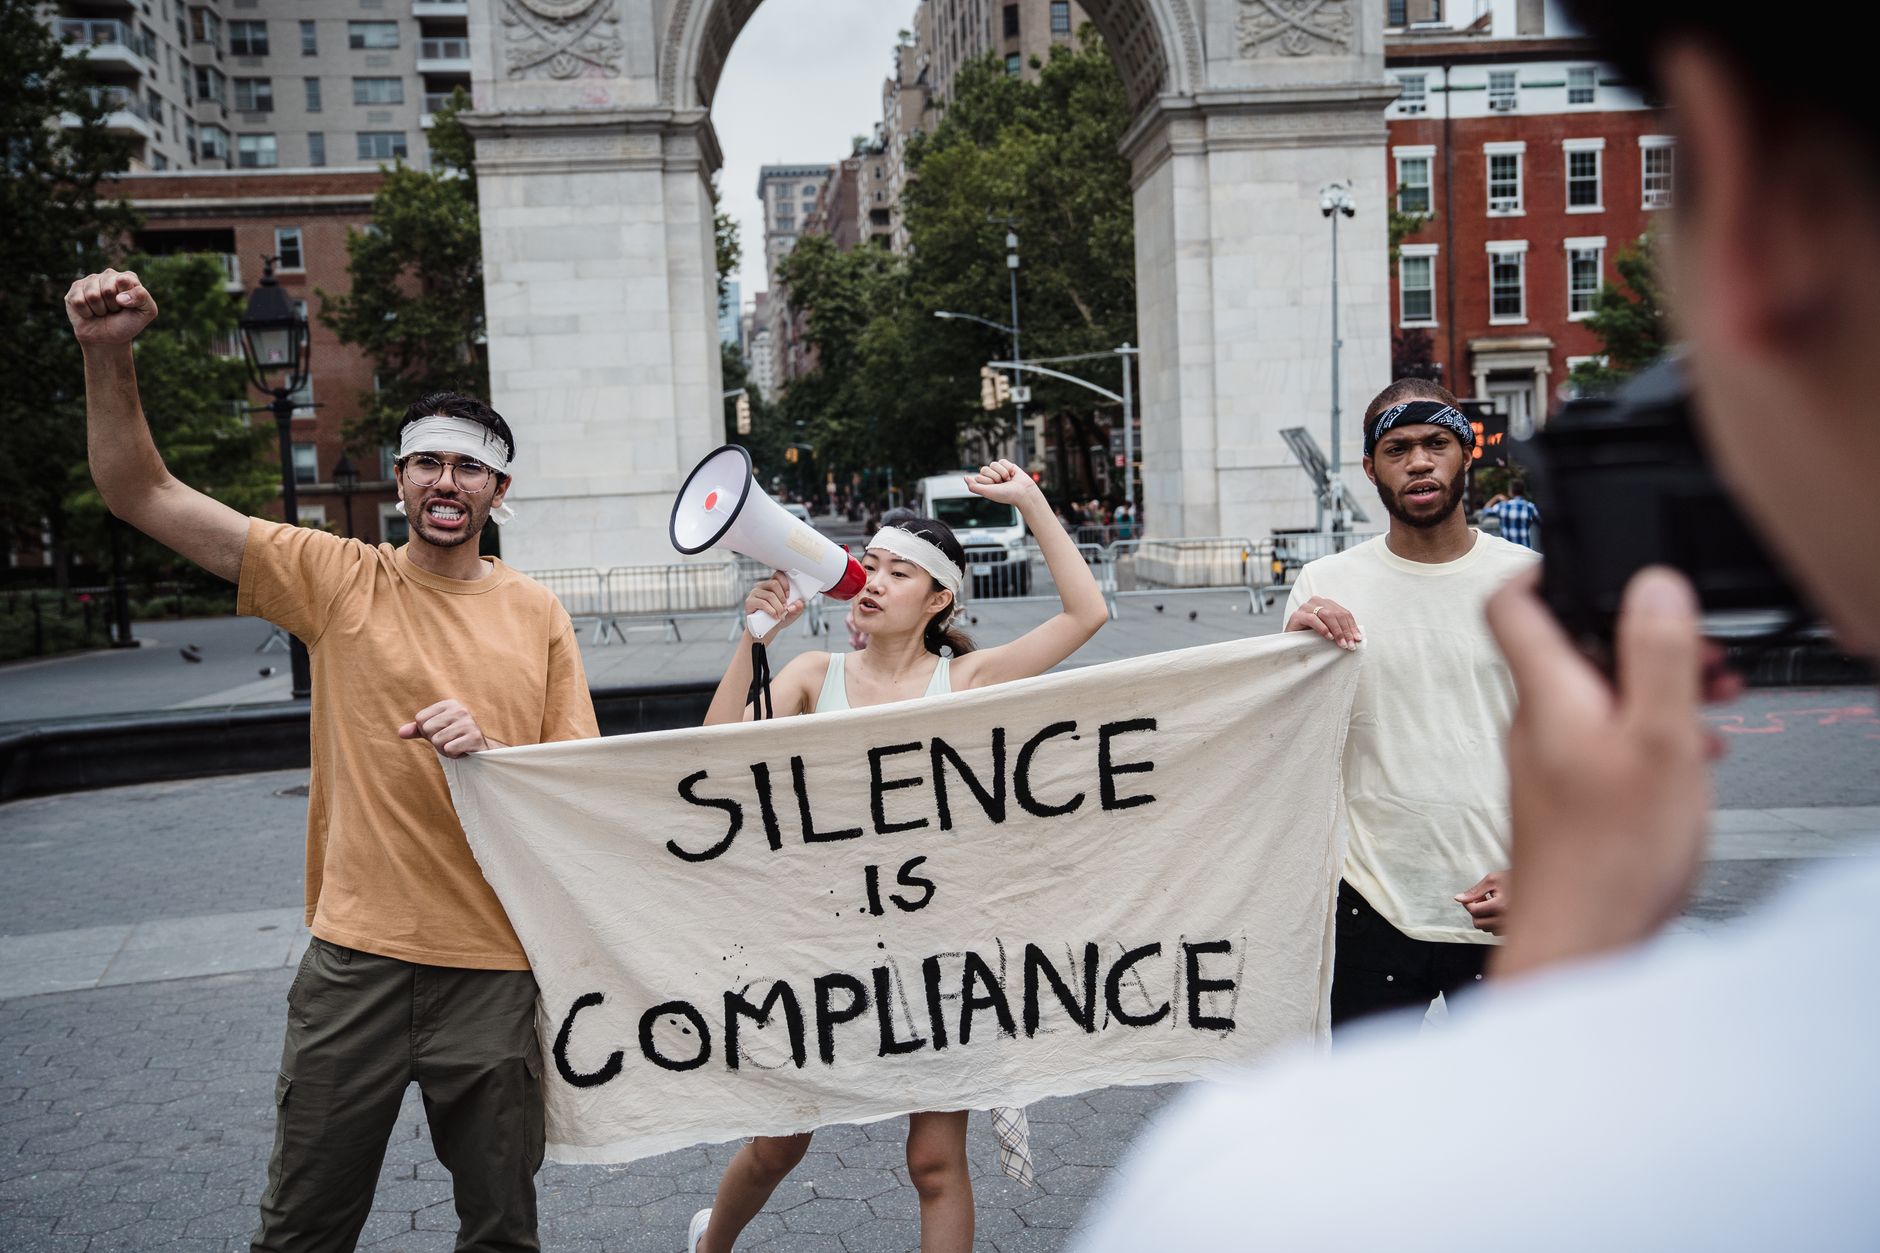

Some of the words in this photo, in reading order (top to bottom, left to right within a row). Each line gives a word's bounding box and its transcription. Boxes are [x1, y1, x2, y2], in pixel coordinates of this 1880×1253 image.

[666, 717, 1157, 863] SILENCE
[865, 855, 937, 917] IS
[552, 939, 1237, 1089] COMPLIANCE
